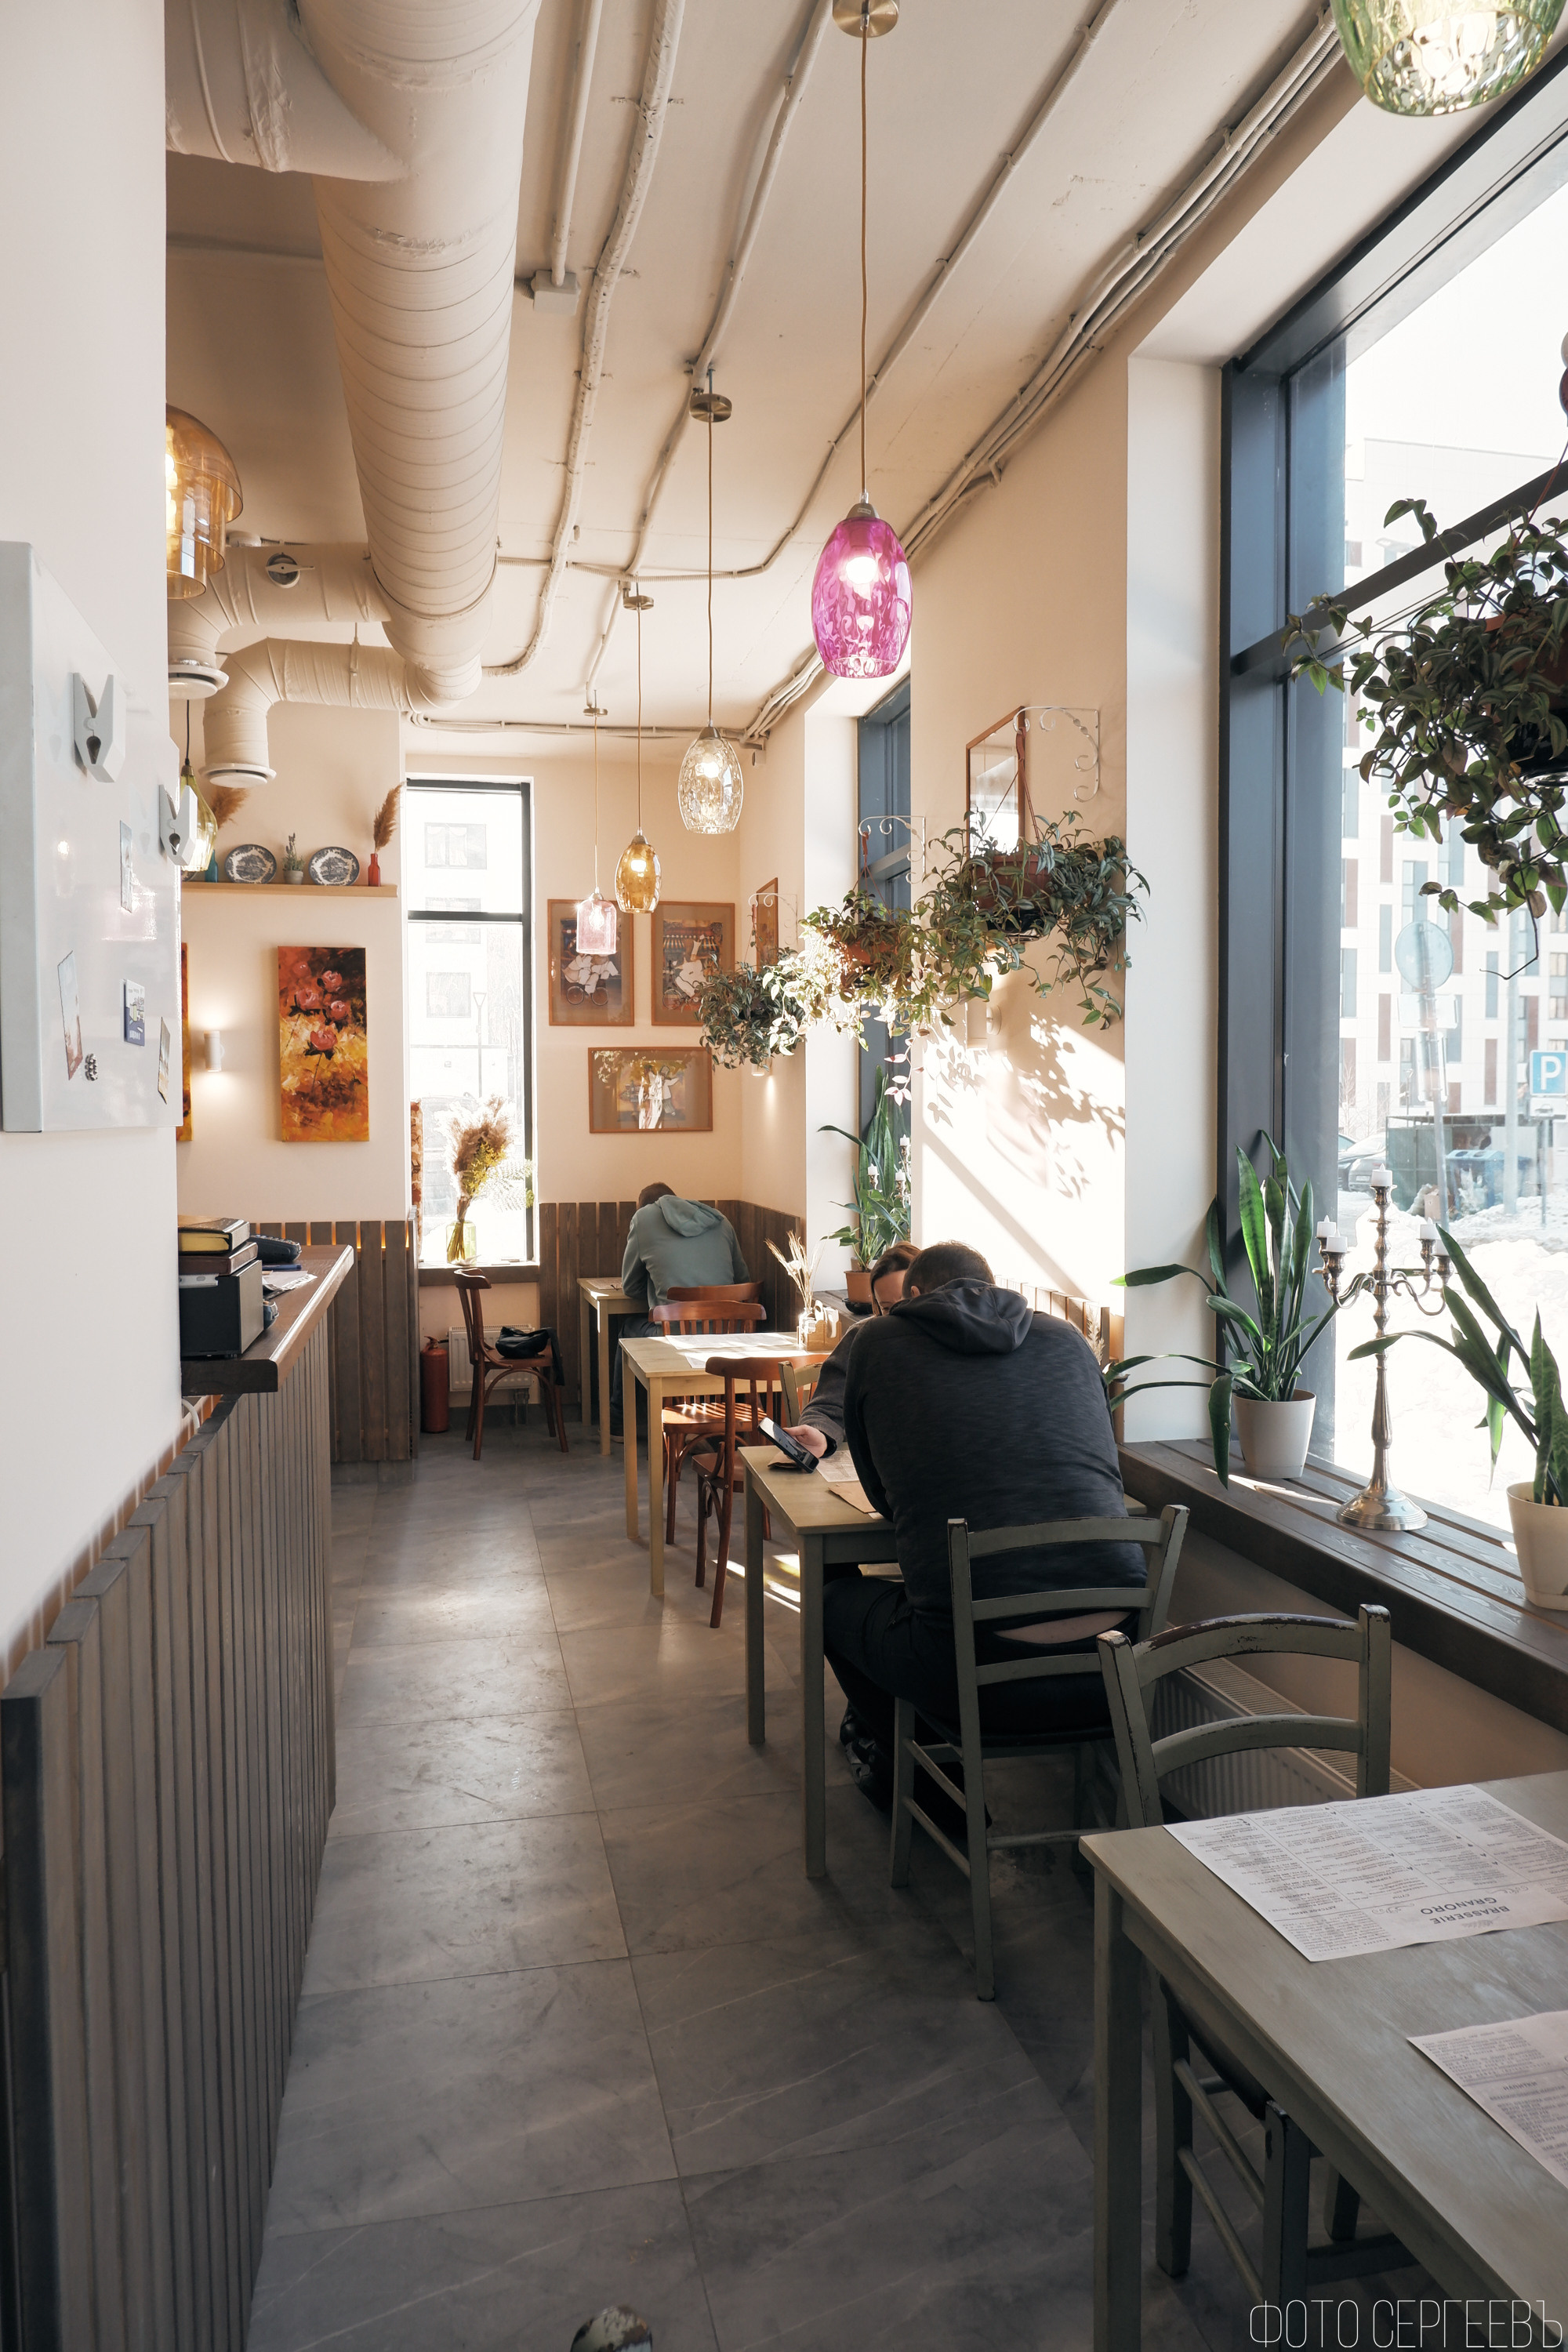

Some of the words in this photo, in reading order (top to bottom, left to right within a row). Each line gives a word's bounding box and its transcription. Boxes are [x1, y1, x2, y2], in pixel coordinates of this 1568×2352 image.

[1541, 1055, 1562, 1091] P
[1420, 1896, 1497, 1915] GRANORO
[1430, 1906, 1511, 1925] BRASSERIE
